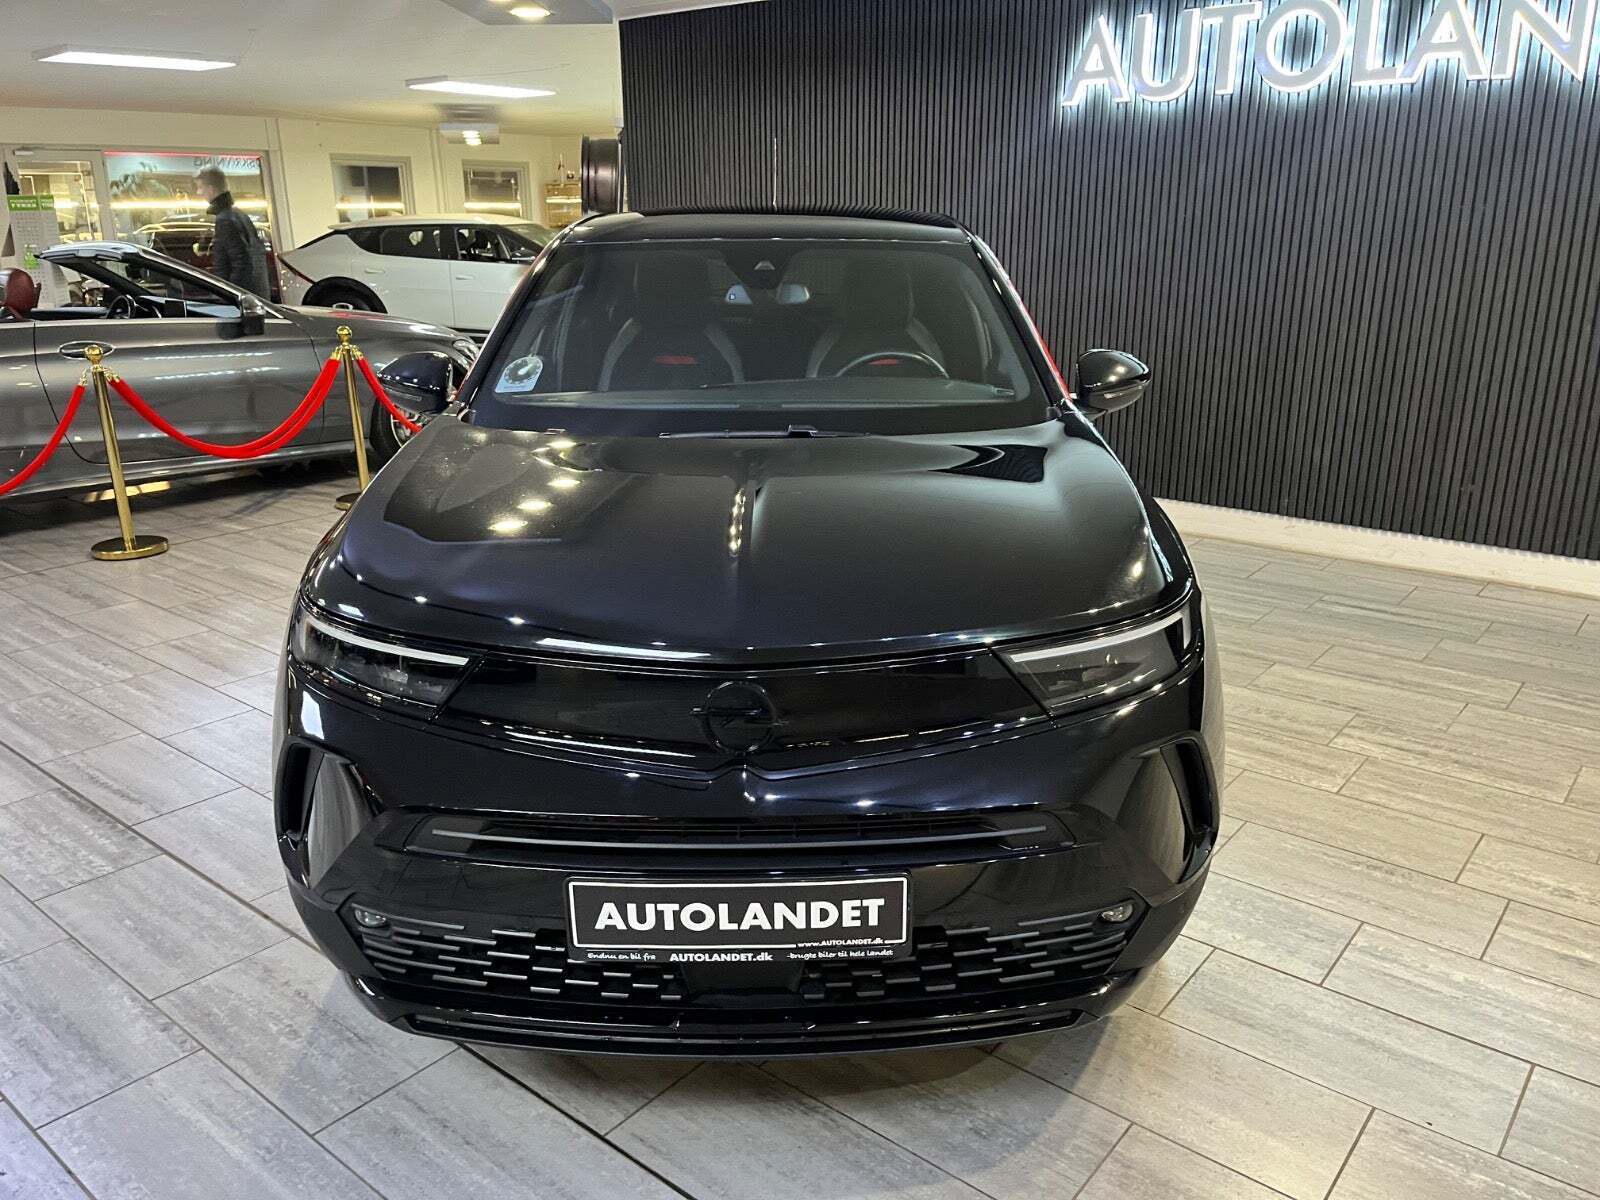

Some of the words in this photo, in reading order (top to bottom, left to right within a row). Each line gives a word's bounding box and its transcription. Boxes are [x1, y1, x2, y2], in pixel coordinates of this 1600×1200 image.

[1061, 0, 1597, 107] AUTOLAN
[594, 898, 885, 931] AUTOLANDET
[797, 937, 884, 948] www.AUTOLANDET.dk
[587, 952, 617, 960] Endnu
[630, 952, 642, 960] bil
[643, 953, 656, 962] fra
[669, 952, 773, 962] AUTOLANDET.dk
[818, 951, 836, 959] biler
[838, 950, 848, 958] til
[850, 949, 865, 957] hele
[866, 949, 894, 957] landet
